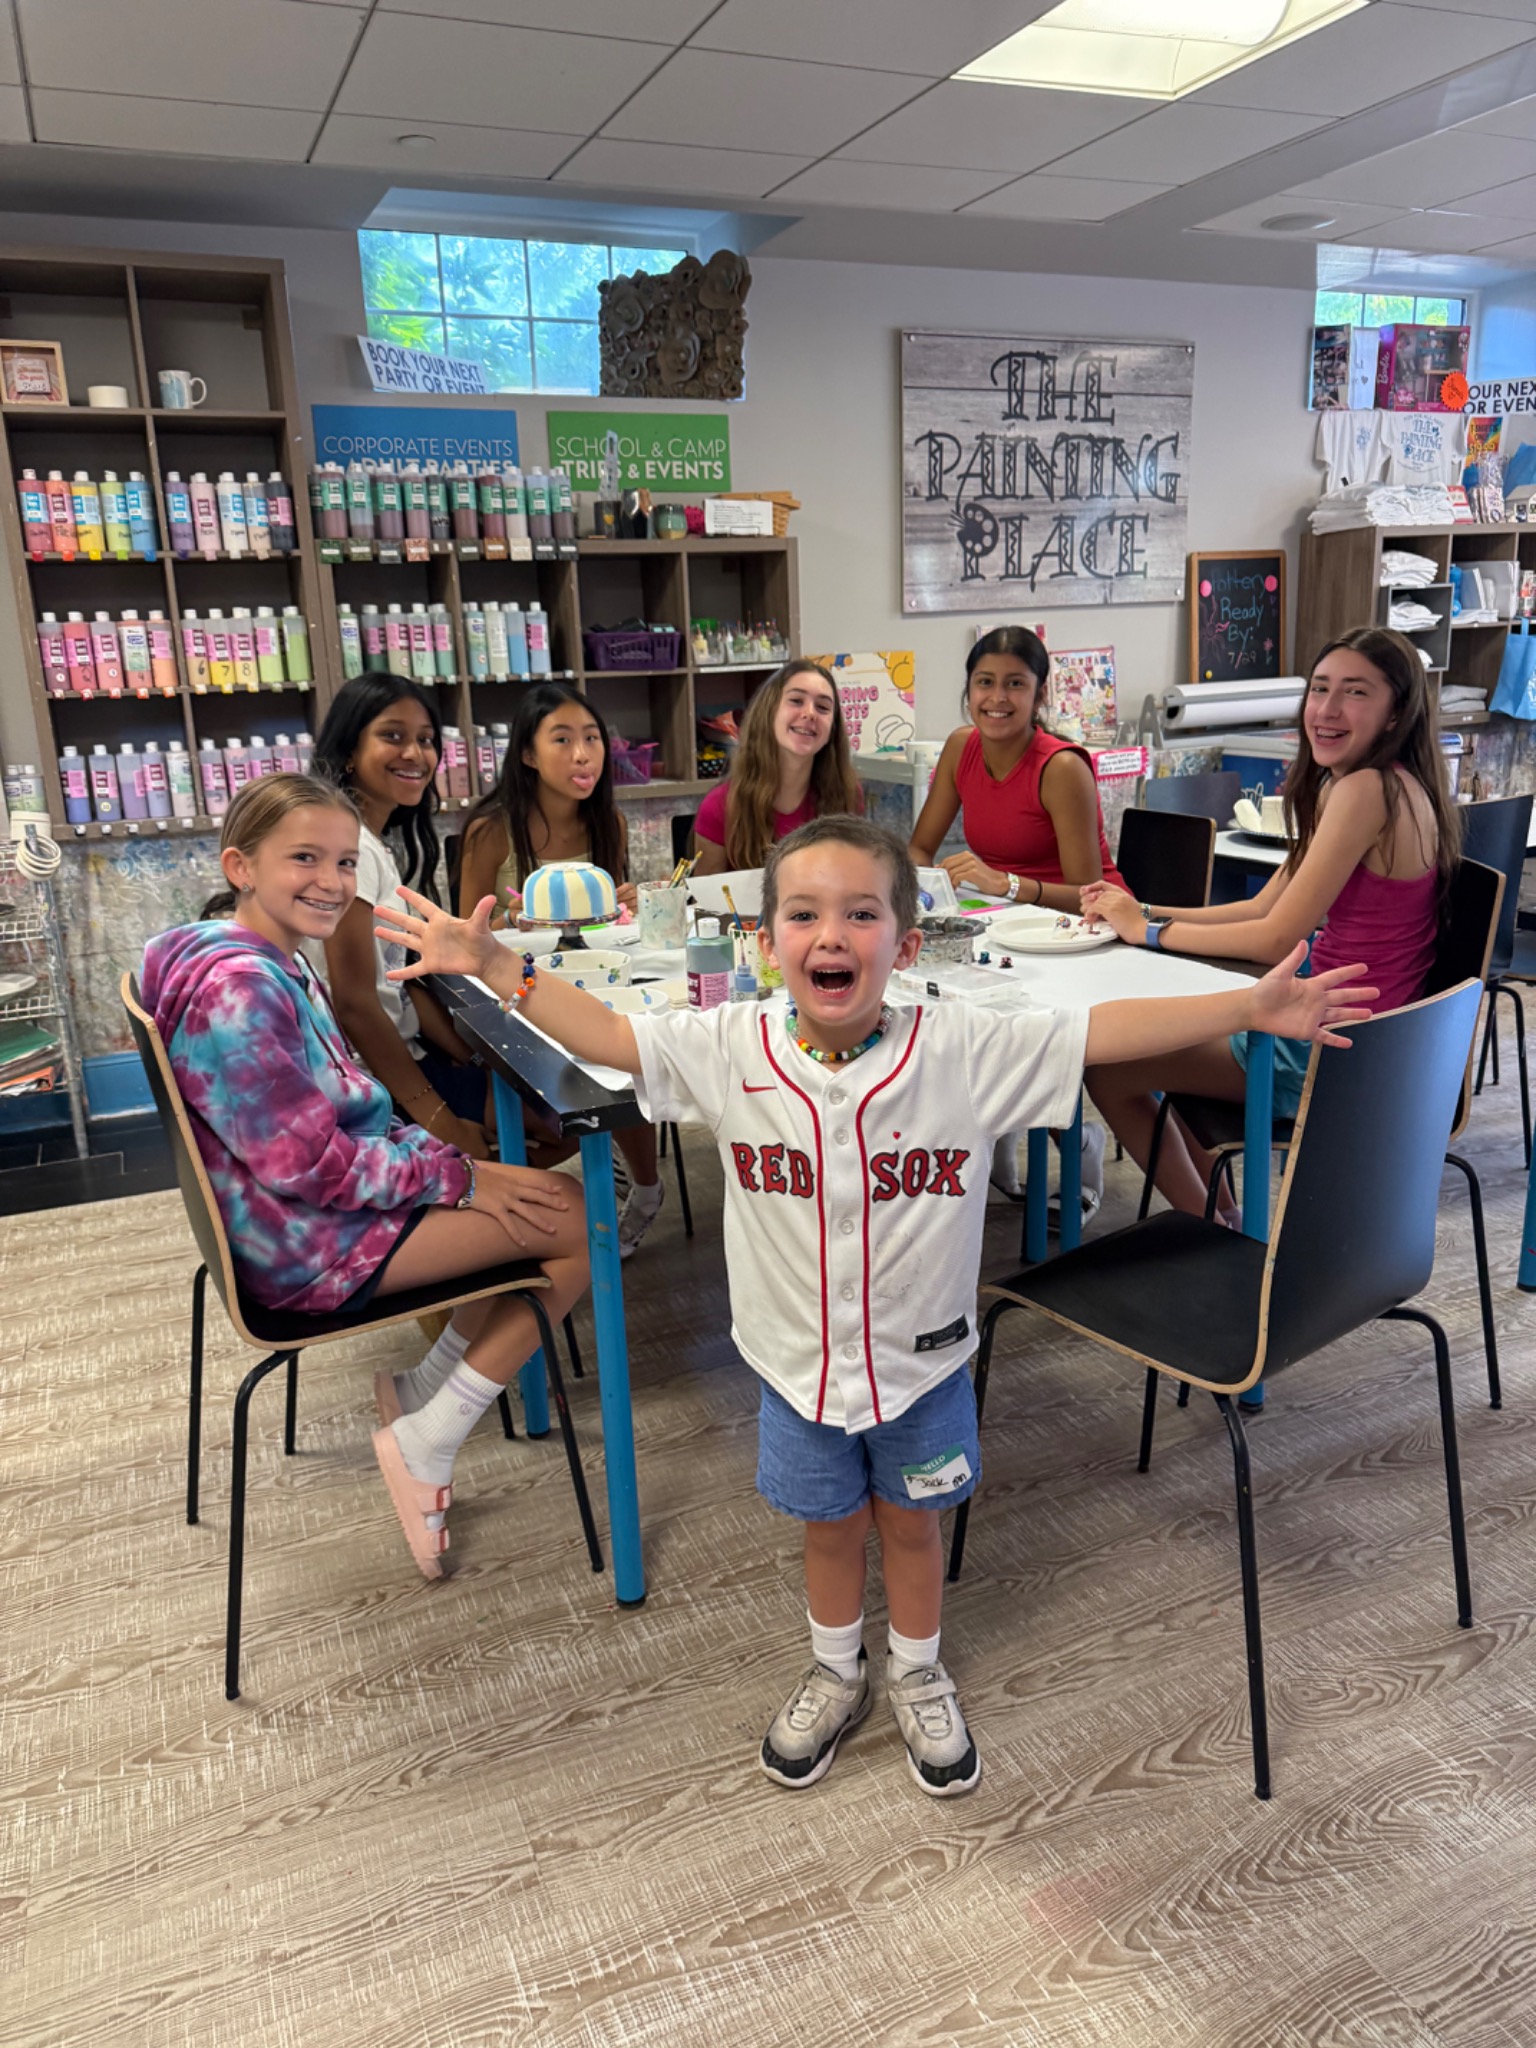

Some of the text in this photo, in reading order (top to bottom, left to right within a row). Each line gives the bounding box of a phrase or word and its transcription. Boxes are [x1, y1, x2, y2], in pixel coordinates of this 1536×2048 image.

[366, 342, 481, 383] BOOK YOUR NEXT
[373, 363, 418, 390] PARTY
[421, 374, 445, 393] OR
[991, 350, 1117, 426] THE
[1468, 383, 1502, 400] OUR
[1507, 381, 1536, 398] NEX
[1461, 400, 1486, 415] OR
[1493, 397, 1536, 414] EVEN
[323, 436, 514, 458] CORPORATE EVENTS
[651, 442, 663, 458] &
[668, 438, 727, 458] CAMP
[628, 463, 640, 479] &
[645, 460, 724, 480] EVENTS
[914, 430, 1181, 510] PAINTING
[955, 503, 1150, 591] PLACE
[1221, 597, 1264, 628] Ready
[1227, 623, 1254, 651] By:
[198, 660, 205, 676] 6
[242, 662, 251, 677] 8
[1228, 650, 1257, 670] 7/29
[221, 665, 230, 676] 7
[837, 685, 879, 703] RING
[842, 703, 869, 720] STS
[730, 1141, 970, 1204] RED SOX
[920, 1455, 946, 1472] HELLO
